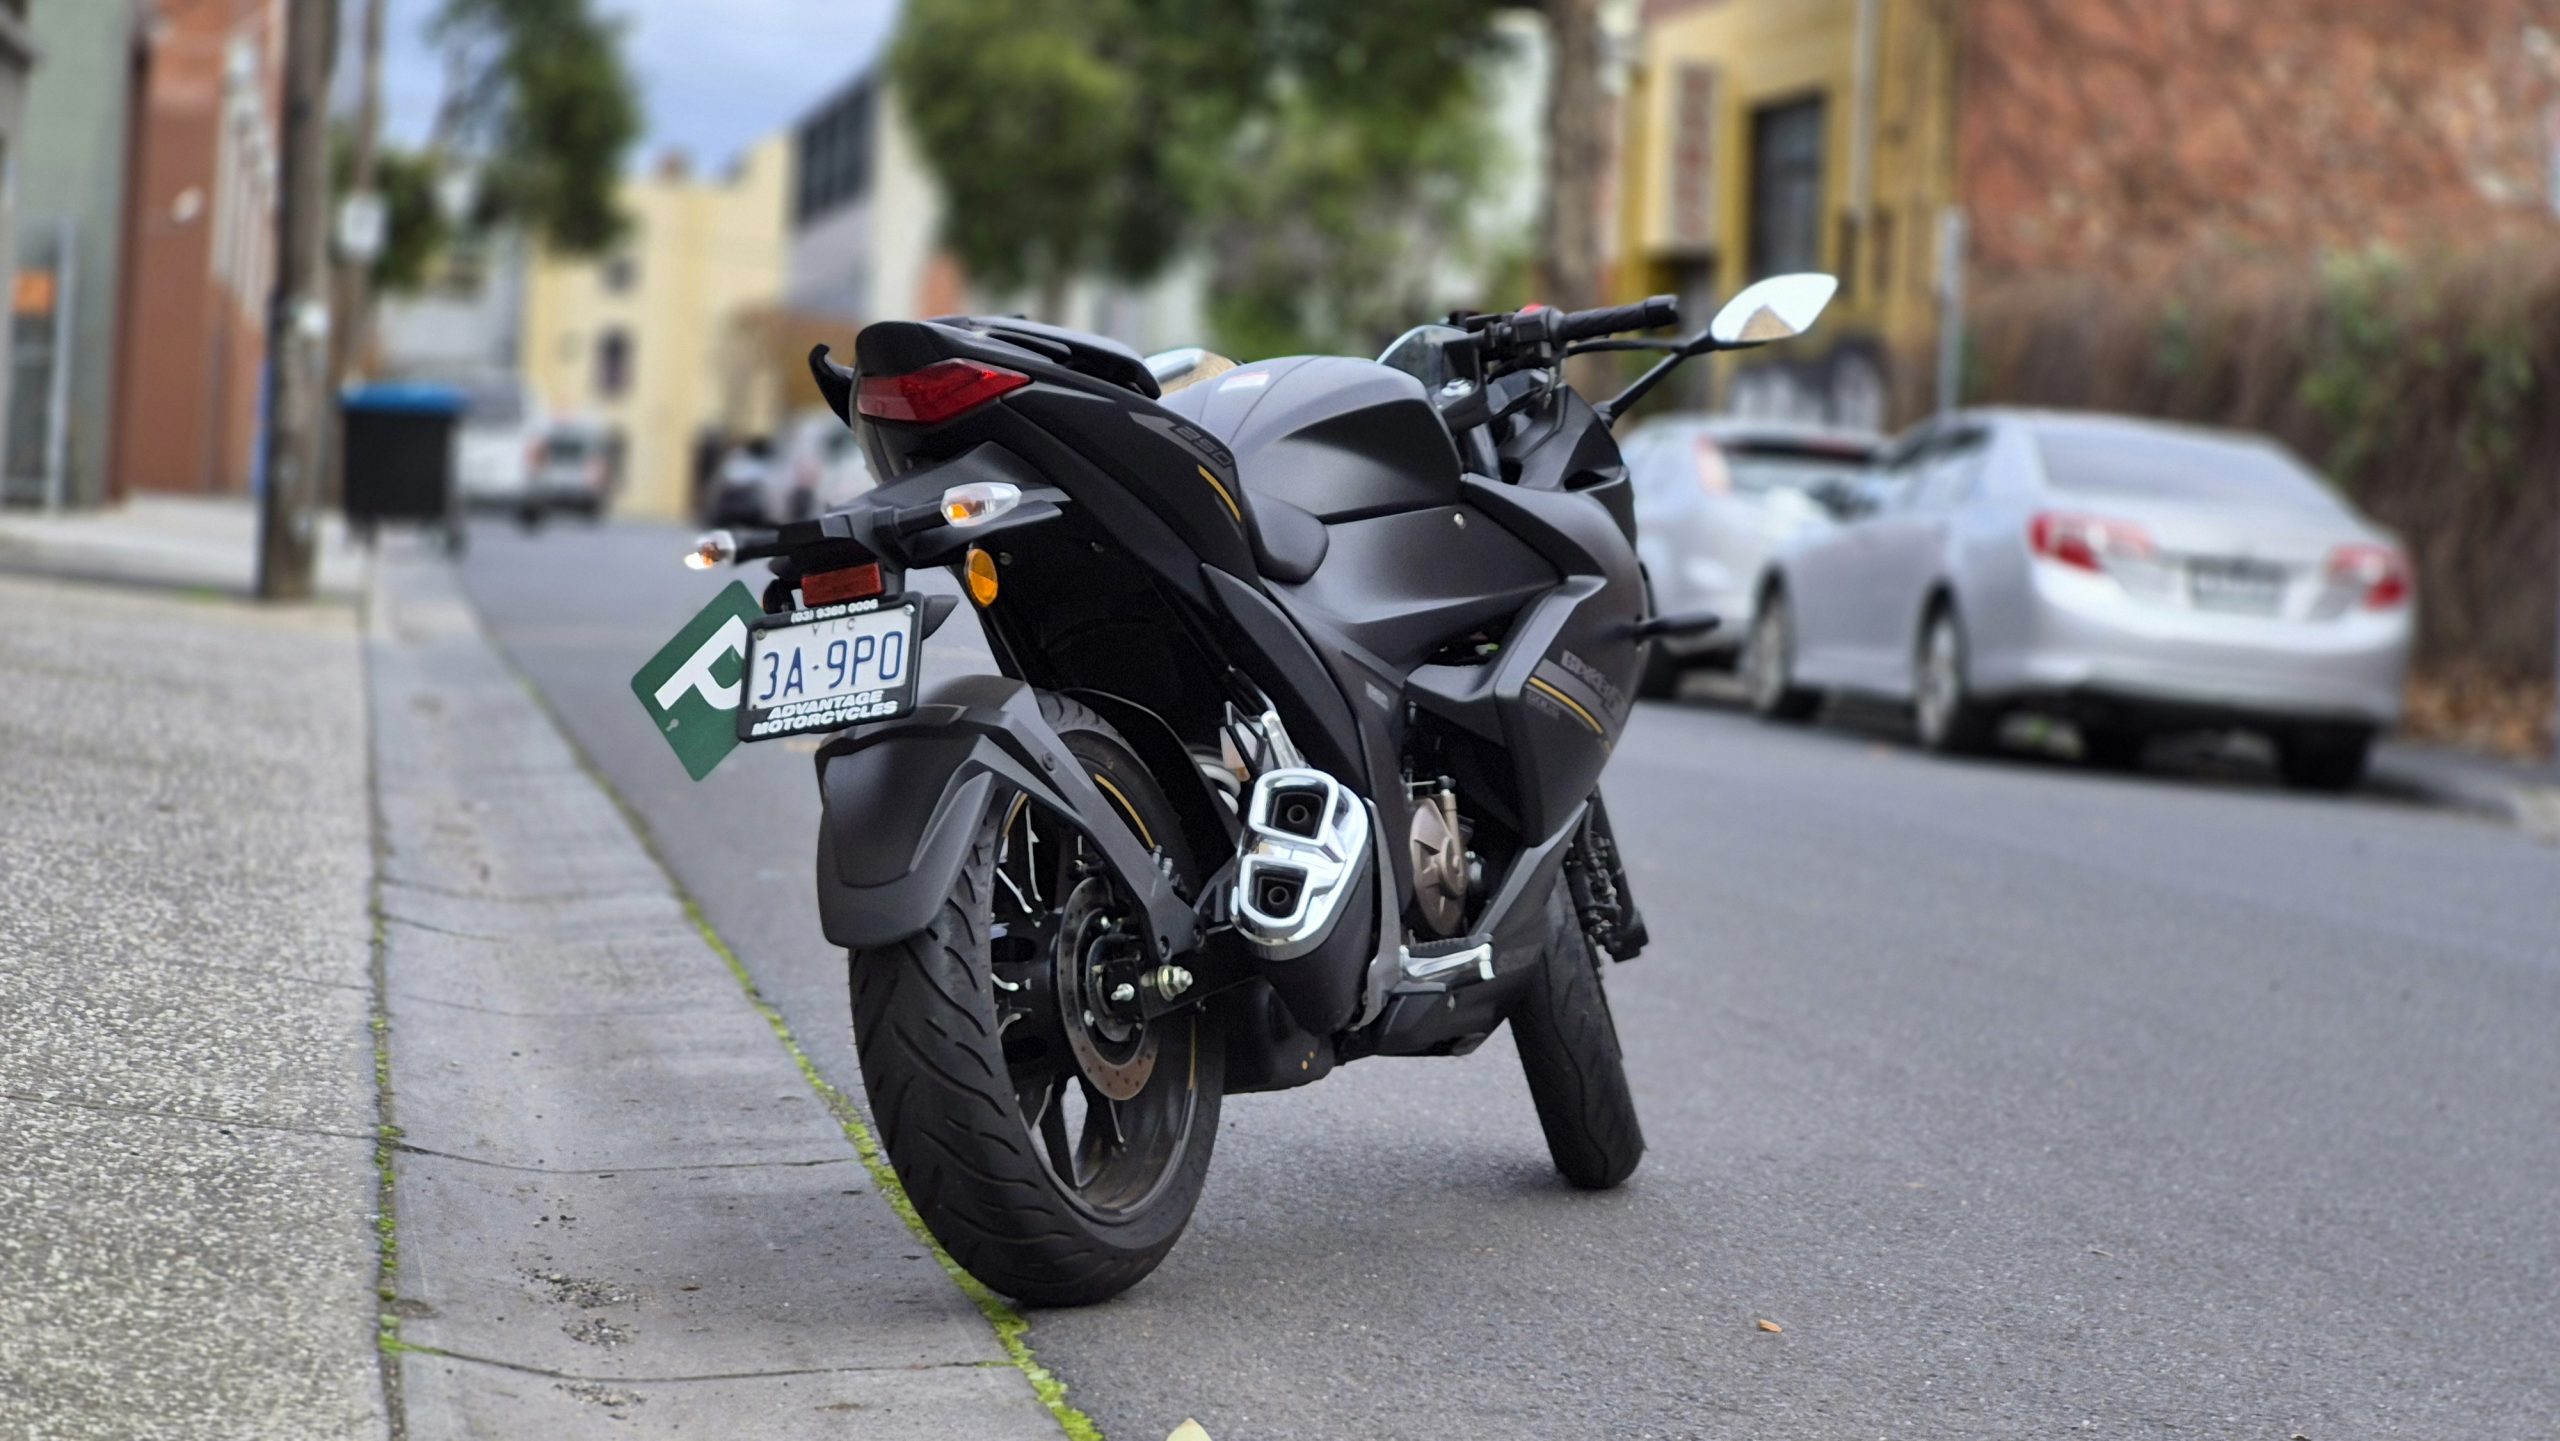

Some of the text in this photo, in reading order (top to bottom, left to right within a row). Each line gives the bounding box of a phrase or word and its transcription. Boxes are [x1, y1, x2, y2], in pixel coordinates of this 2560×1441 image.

[1173, 425, 1233, 466] 250
[790, 608, 813, 624] (03)
[816, 603, 846, 619] 9360
[812, 618, 856, 635] VIC
[654, 613, 748, 711] P
[751, 700, 899, 737] MOTORCYCLES
[767, 689, 885, 719] ADVANTAGE
